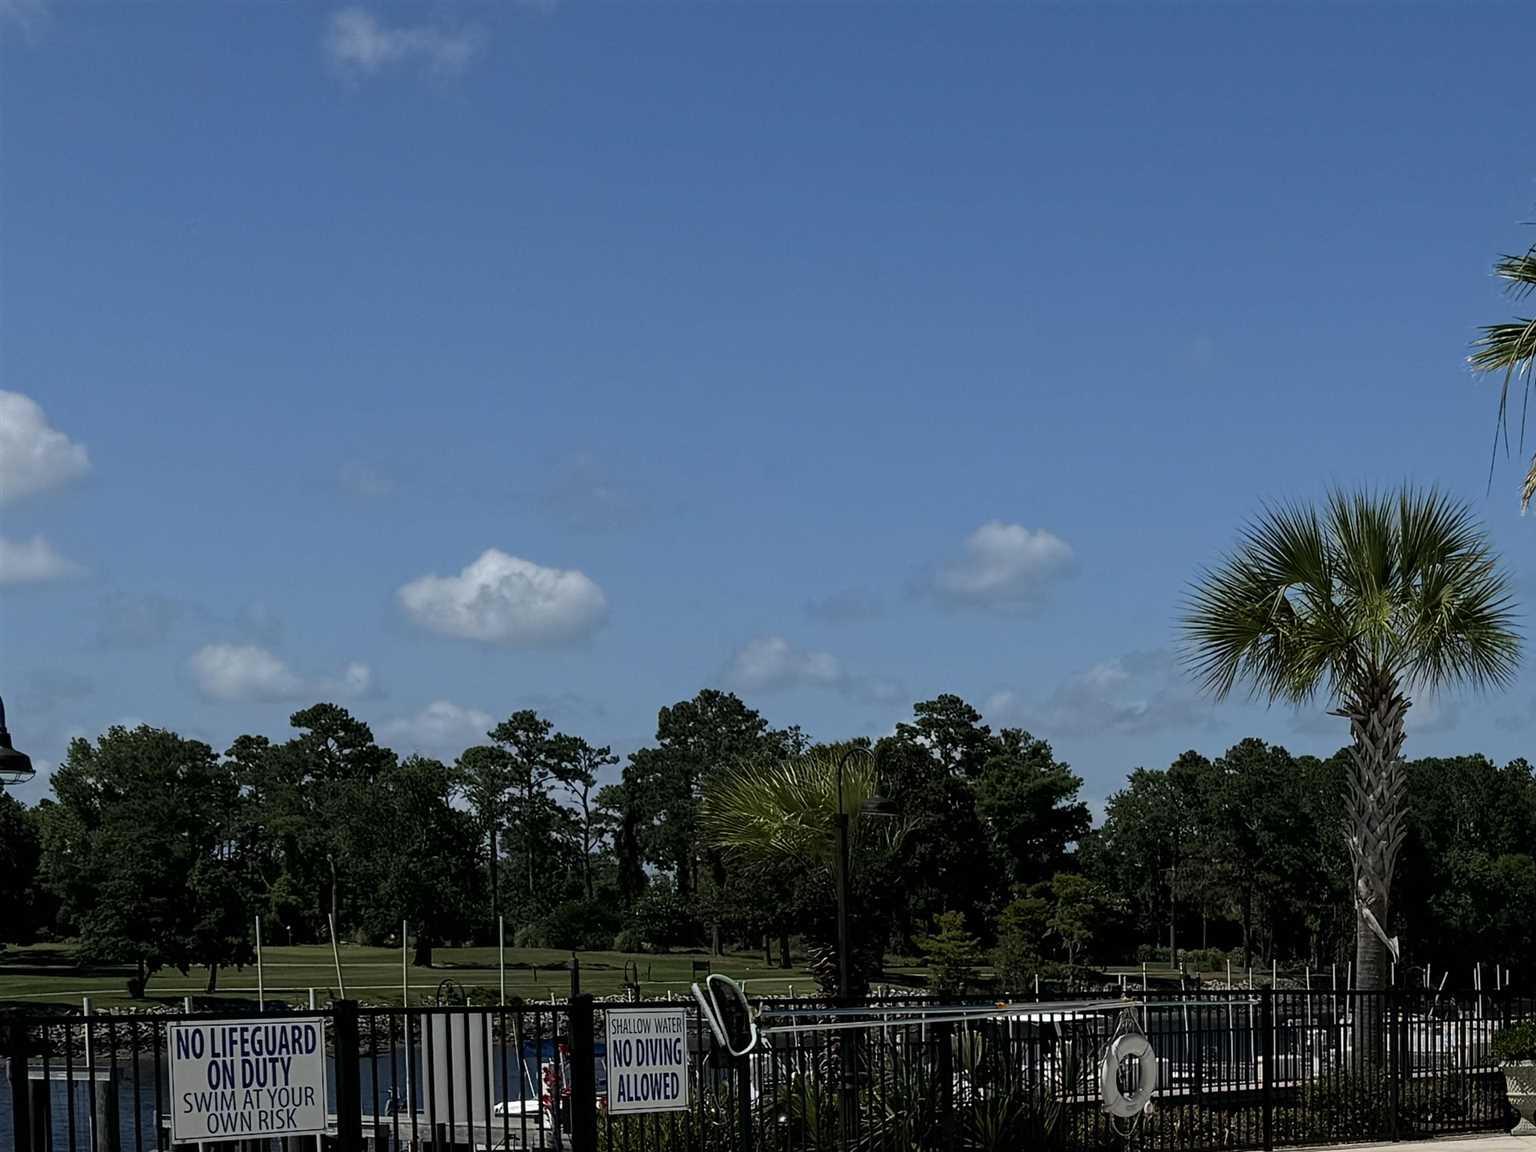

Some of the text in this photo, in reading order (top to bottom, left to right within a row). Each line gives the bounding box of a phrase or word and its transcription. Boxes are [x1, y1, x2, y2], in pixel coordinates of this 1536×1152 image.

[612, 1017, 682, 1034] SHALLOW WATER
[176, 1025, 316, 1060] NO LIFEGUARD
[613, 1038, 681, 1067] NO DIVING
[208, 1057, 291, 1090] ON DUTY
[618, 1072, 679, 1102] ALLOWED
[184, 1086, 315, 1113] SWIM AT YOUR
[208, 1108, 297, 1134] OWN RISK
